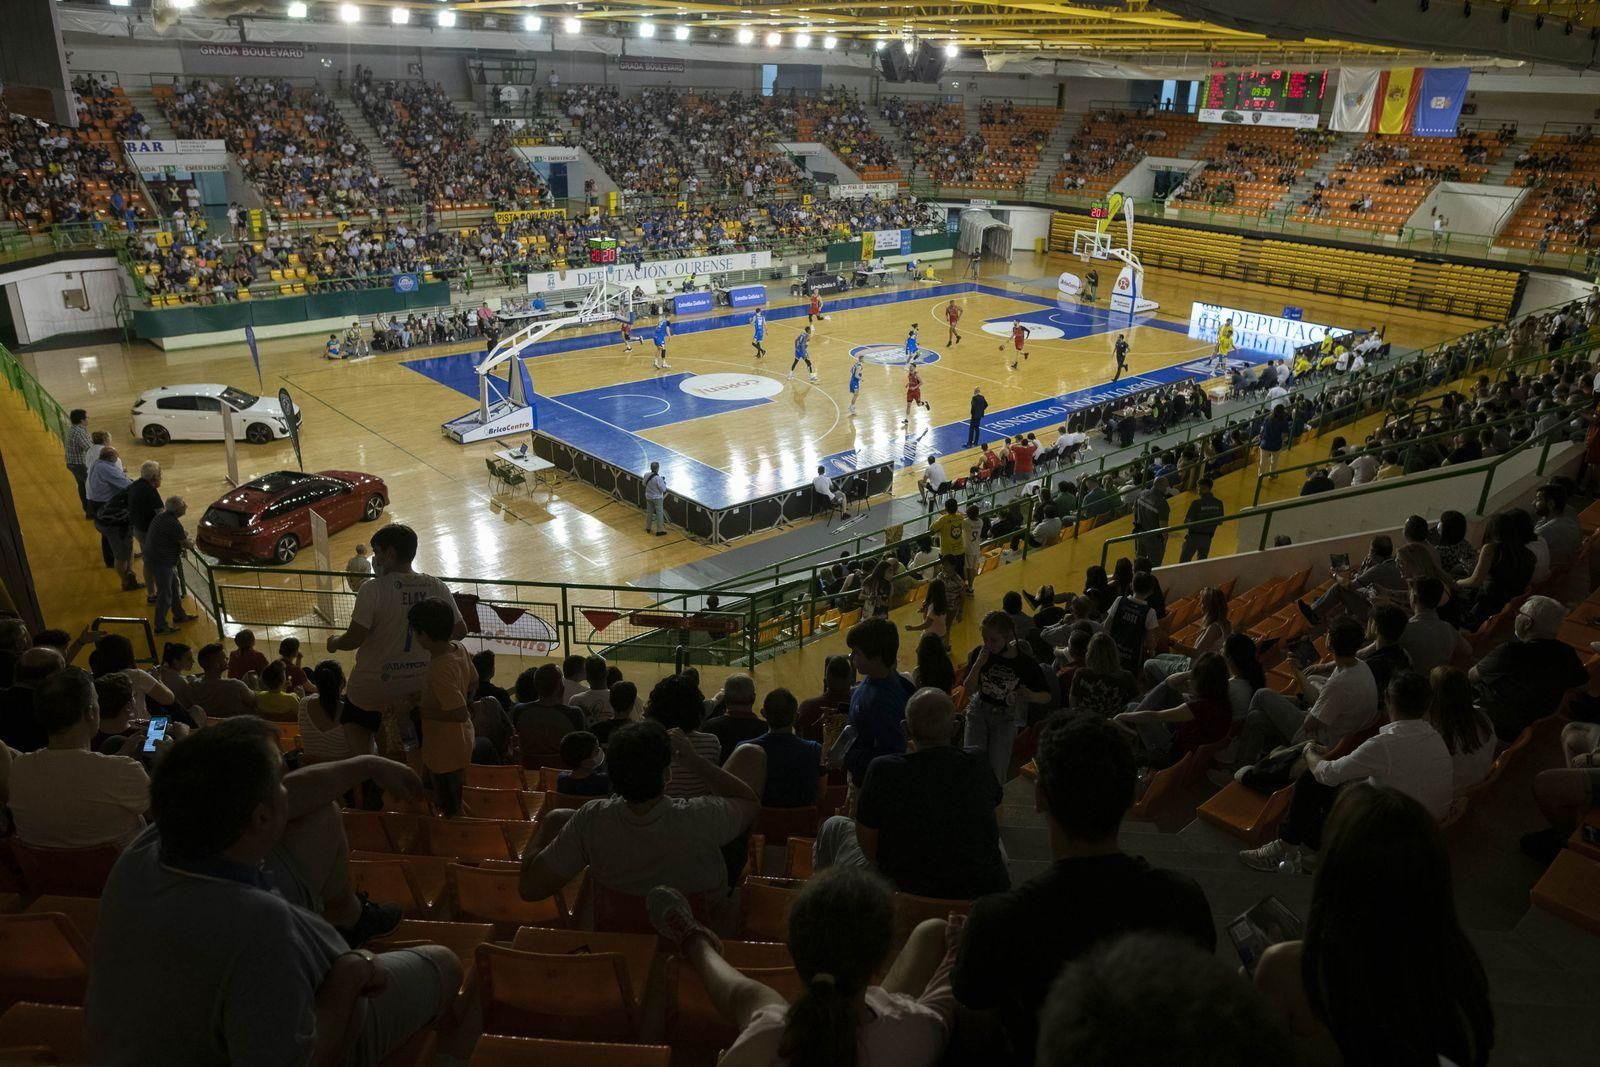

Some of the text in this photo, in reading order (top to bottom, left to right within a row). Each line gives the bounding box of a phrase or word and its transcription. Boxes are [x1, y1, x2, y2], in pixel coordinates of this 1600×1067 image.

[200, 45, 303, 58] GRADA BOULEVARD
[126, 142, 164, 152] BAR
[1091, 207, 1102, 218] 20
[602, 250, 615, 262] 20
[576, 258, 733, 286] DEPUTACIÓN OURENSE
[985, 405, 1068, 431] OURENSE
[489, 422, 529, 434] BricoCentro
